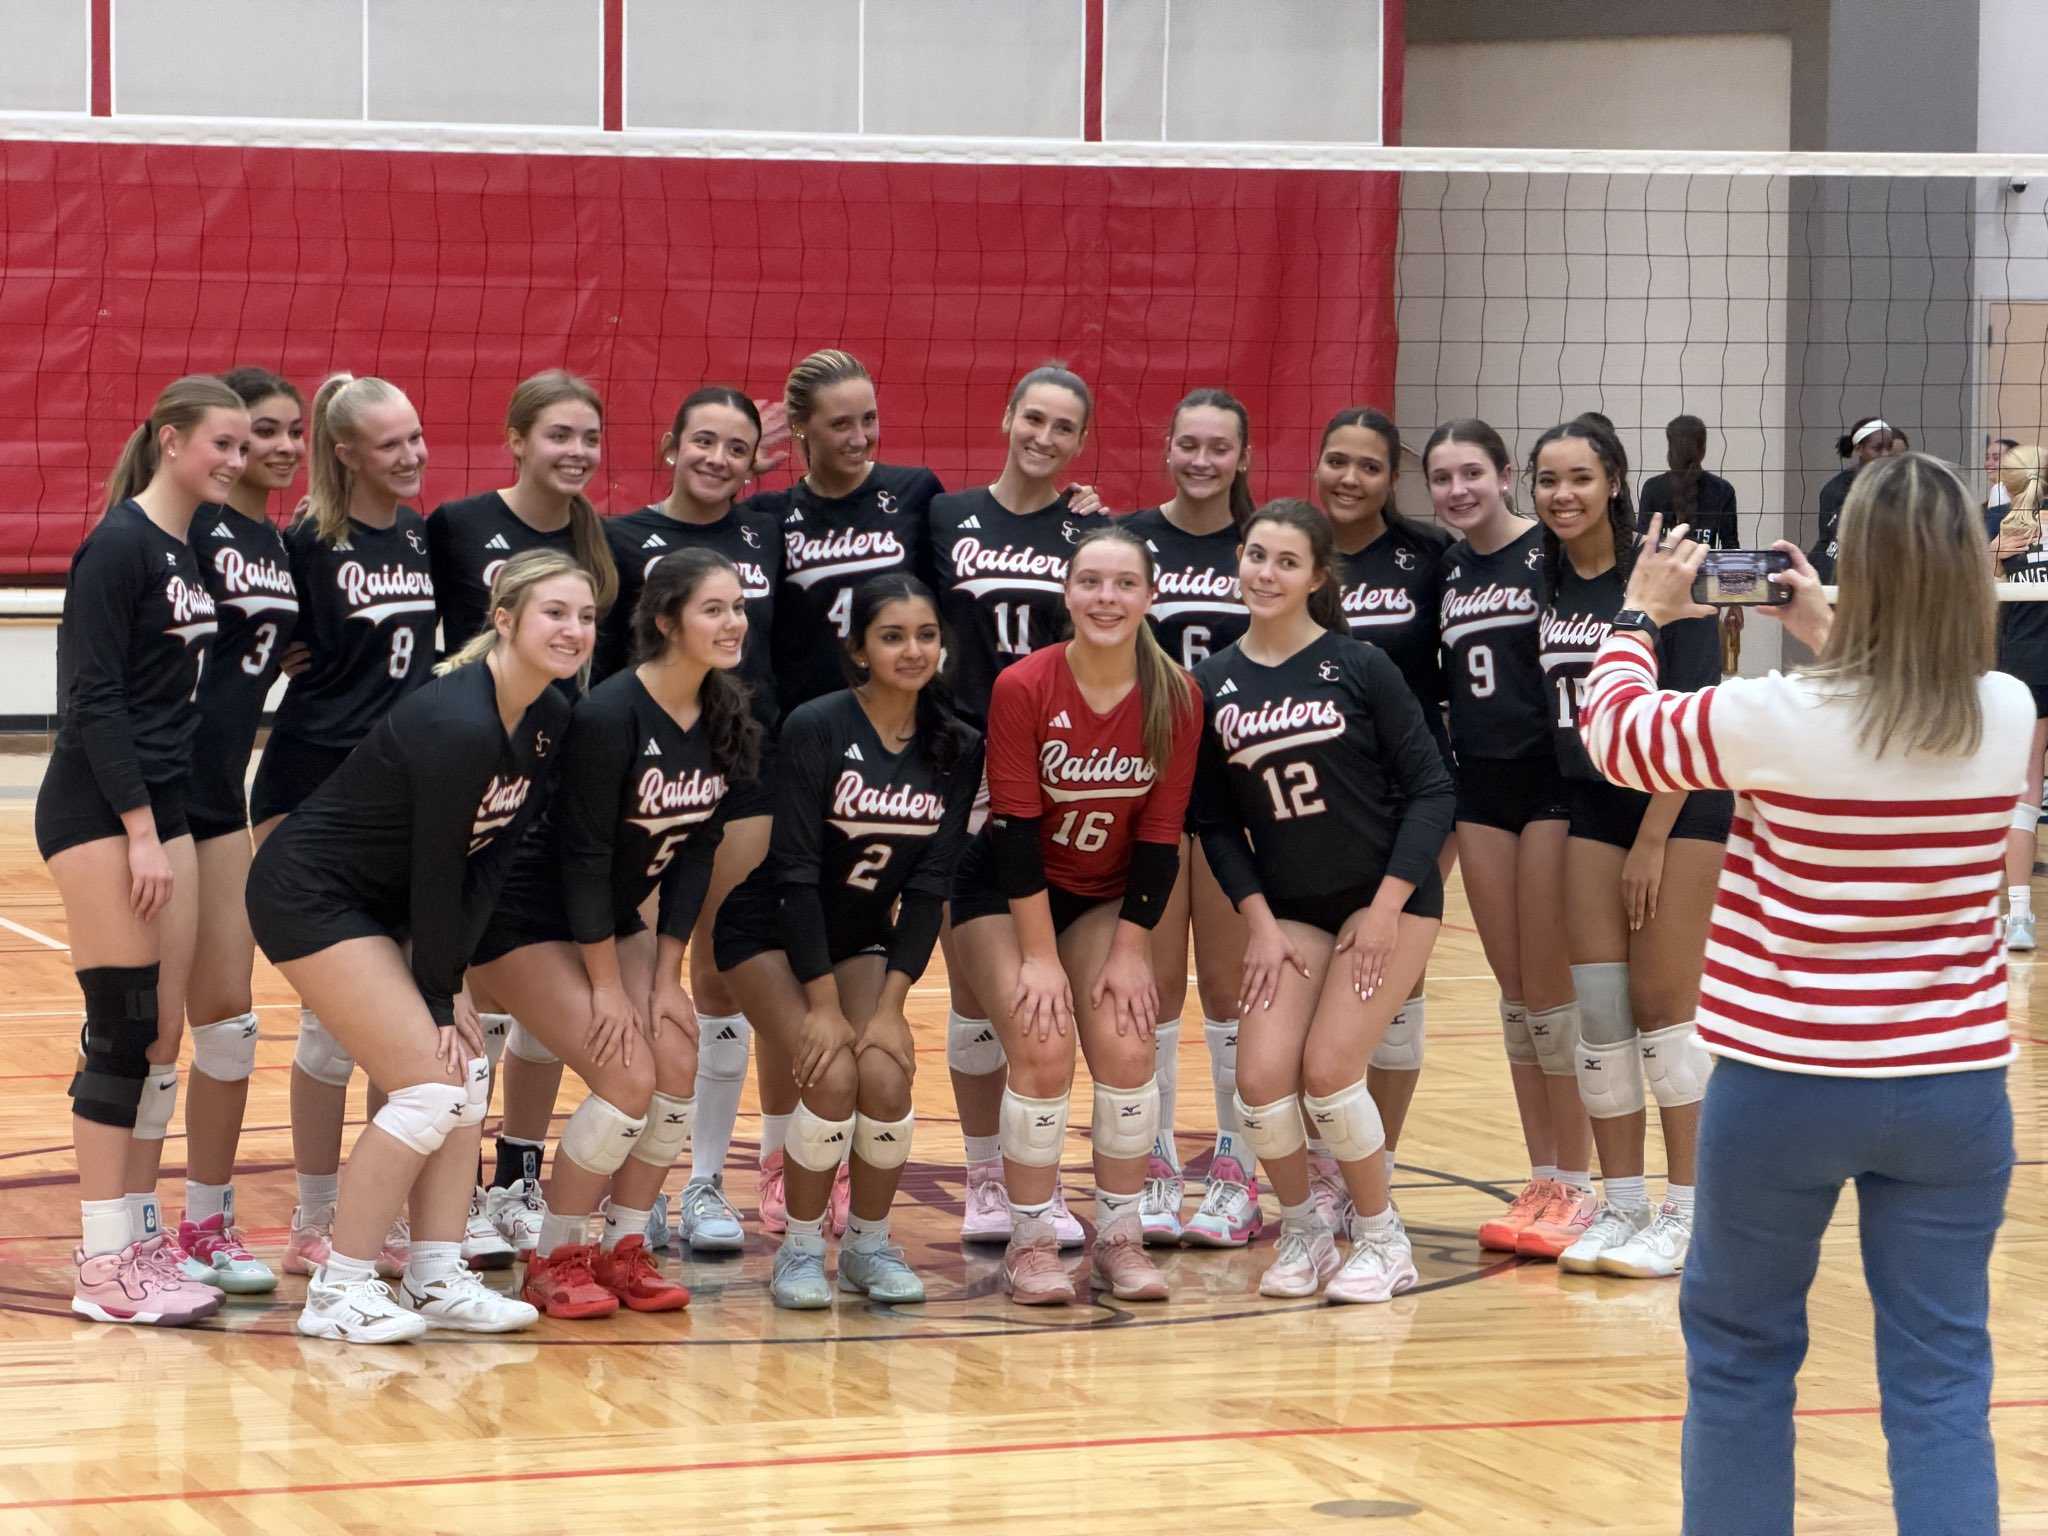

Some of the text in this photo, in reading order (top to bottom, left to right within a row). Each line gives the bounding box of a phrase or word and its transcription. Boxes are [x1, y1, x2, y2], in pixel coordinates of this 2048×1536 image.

[214, 546, 297, 596] Raider
[1152, 562, 1243, 599] aider
[827, 587, 854, 638] 4
[994, 601, 1032, 655] 11
[241, 622, 278, 676] 3
[388, 626, 414, 680] 8
[1182, 625, 1212, 673] 6
[1467, 644, 1497, 699] 9
[1214, 696, 1346, 751] Raiders
[1038, 739, 1158, 784] Raiders
[1262, 761, 1328, 822] 12
[646, 832, 690, 877] 5
[1051, 810, 1115, 853] 16
[846, 843, 893, 891] 2
